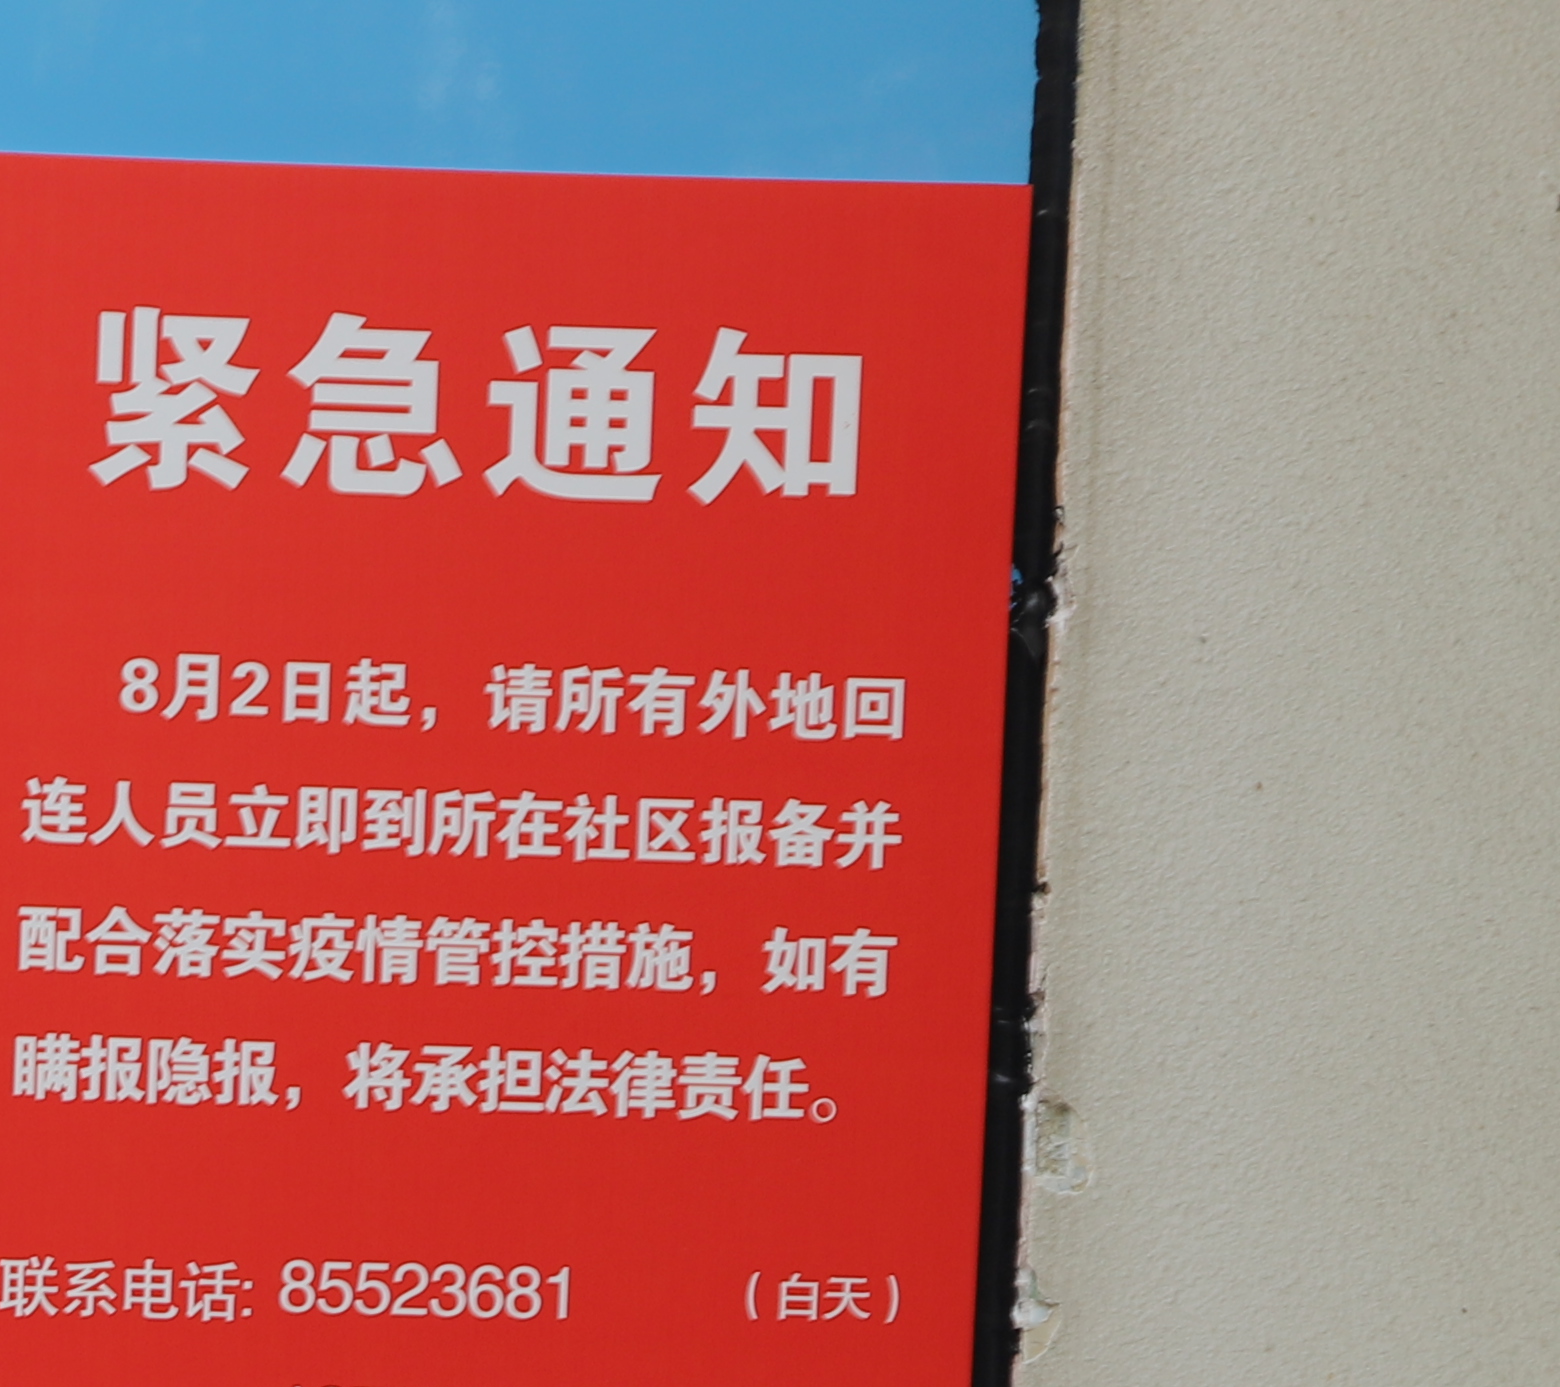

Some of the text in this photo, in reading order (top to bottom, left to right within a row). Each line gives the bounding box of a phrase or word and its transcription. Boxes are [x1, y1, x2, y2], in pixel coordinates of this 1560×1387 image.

[87, 305, 864, 506] 紧急通知
[119, 652, 907, 741] 8月2日起，请所有外地回
[19, 776, 903, 870] 连人员立即到所在社区报备并
[17, 905, 898, 998] 配合落实疫情管控措施，如有
[10, 1033, 839, 1125] 瞒报隐报，将承担法律责任。
[277, 1259, 575, 1320] 85523681
